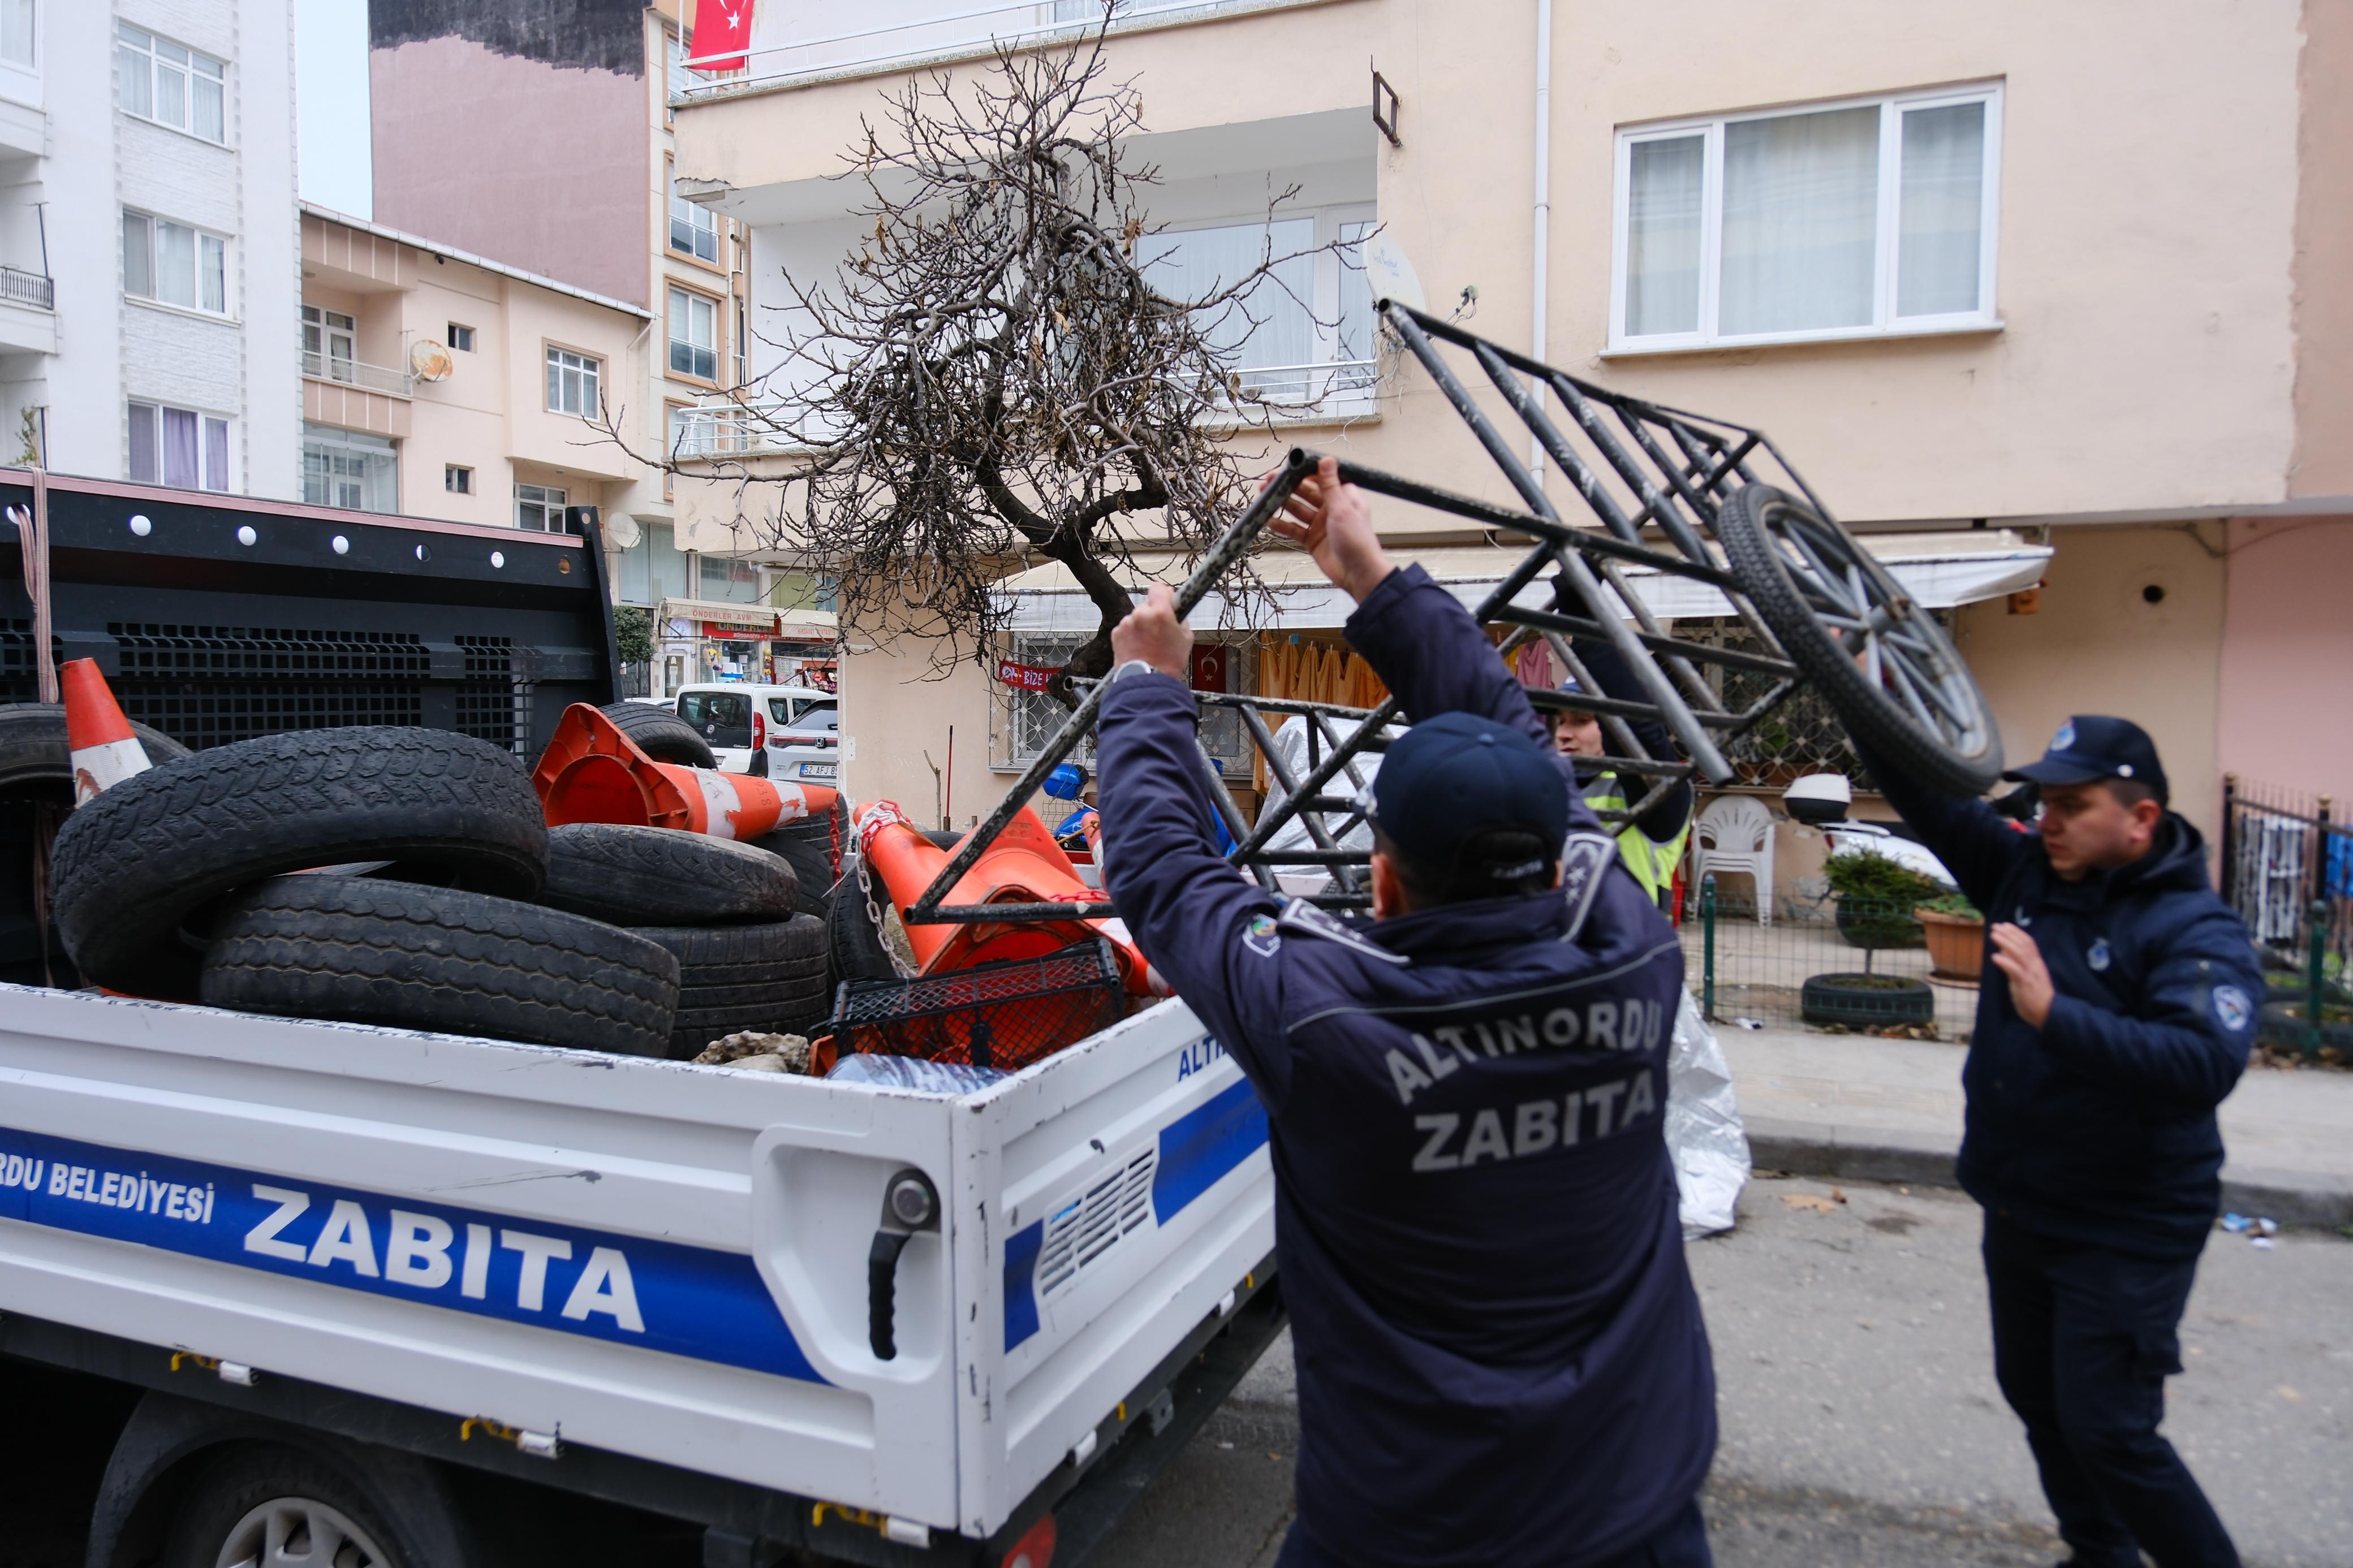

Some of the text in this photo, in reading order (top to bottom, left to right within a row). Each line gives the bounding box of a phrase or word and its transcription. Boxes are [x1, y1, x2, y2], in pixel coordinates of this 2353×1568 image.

[1024, 669, 1042, 686] BİZE
[804, 766, 813, 774] 52
[816, 766, 829, 775] AFJ
[1385, 999, 1663, 1106] ALTINORDU
[1412, 1069, 1655, 1173] ZABITA
[48, 1162, 215, 1224] BELEDİYESİ
[244, 1183, 646, 1333] ZABITA
